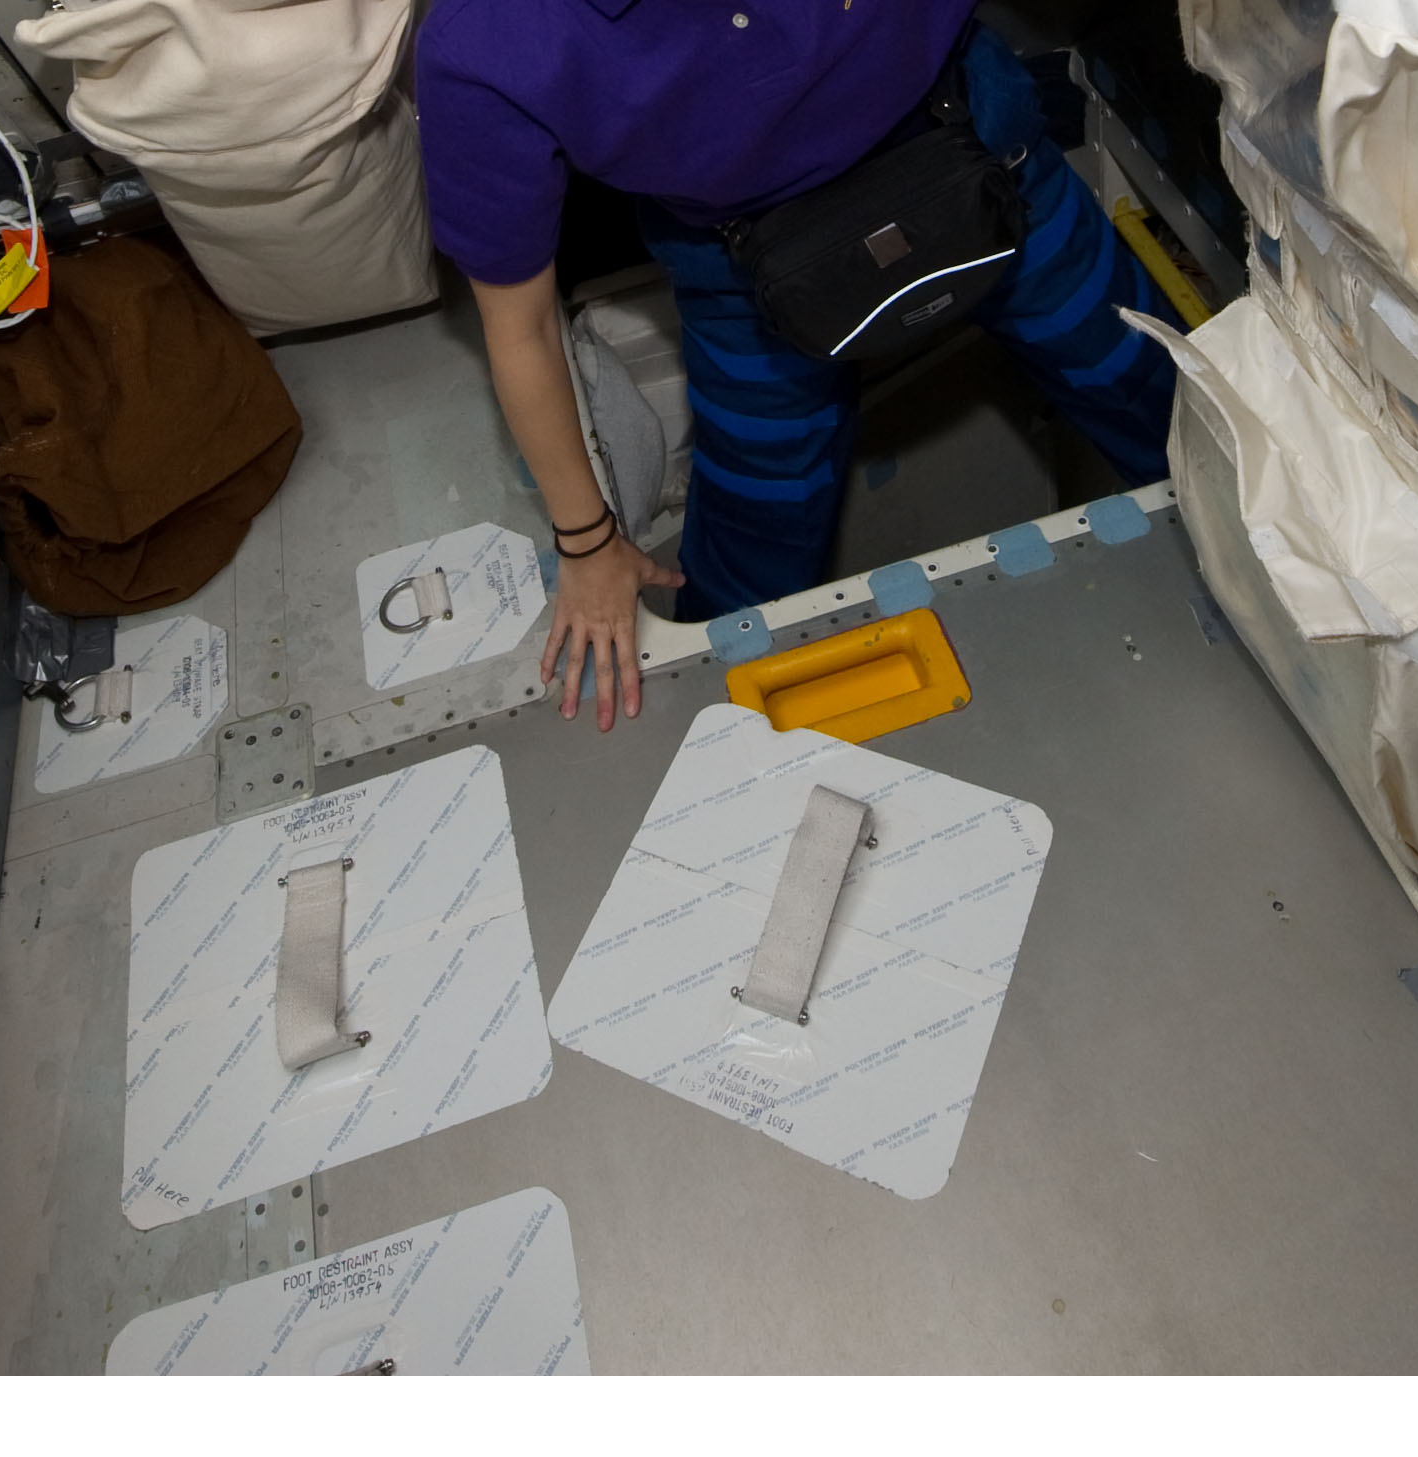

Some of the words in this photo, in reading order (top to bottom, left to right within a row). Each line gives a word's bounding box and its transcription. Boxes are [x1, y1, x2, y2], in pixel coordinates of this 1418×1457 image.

[263, 815, 288, 831] FOOT
[291, 797, 340, 822] RESTRAINT
[343, 788, 367, 805] ASSY
[1004, 806, 1024, 835] Here
[1020, 836, 1039, 857] Pull
[766, 1113, 794, 1134] FOOT
[131, 1166, 155, 1195] Pull
[154, 1183, 190, 1208] Here
[283, 1271, 312, 1292] FOOT
[316, 1250, 379, 1282] RESTRAINT
[384, 1238, 414, 1257] ASSY
